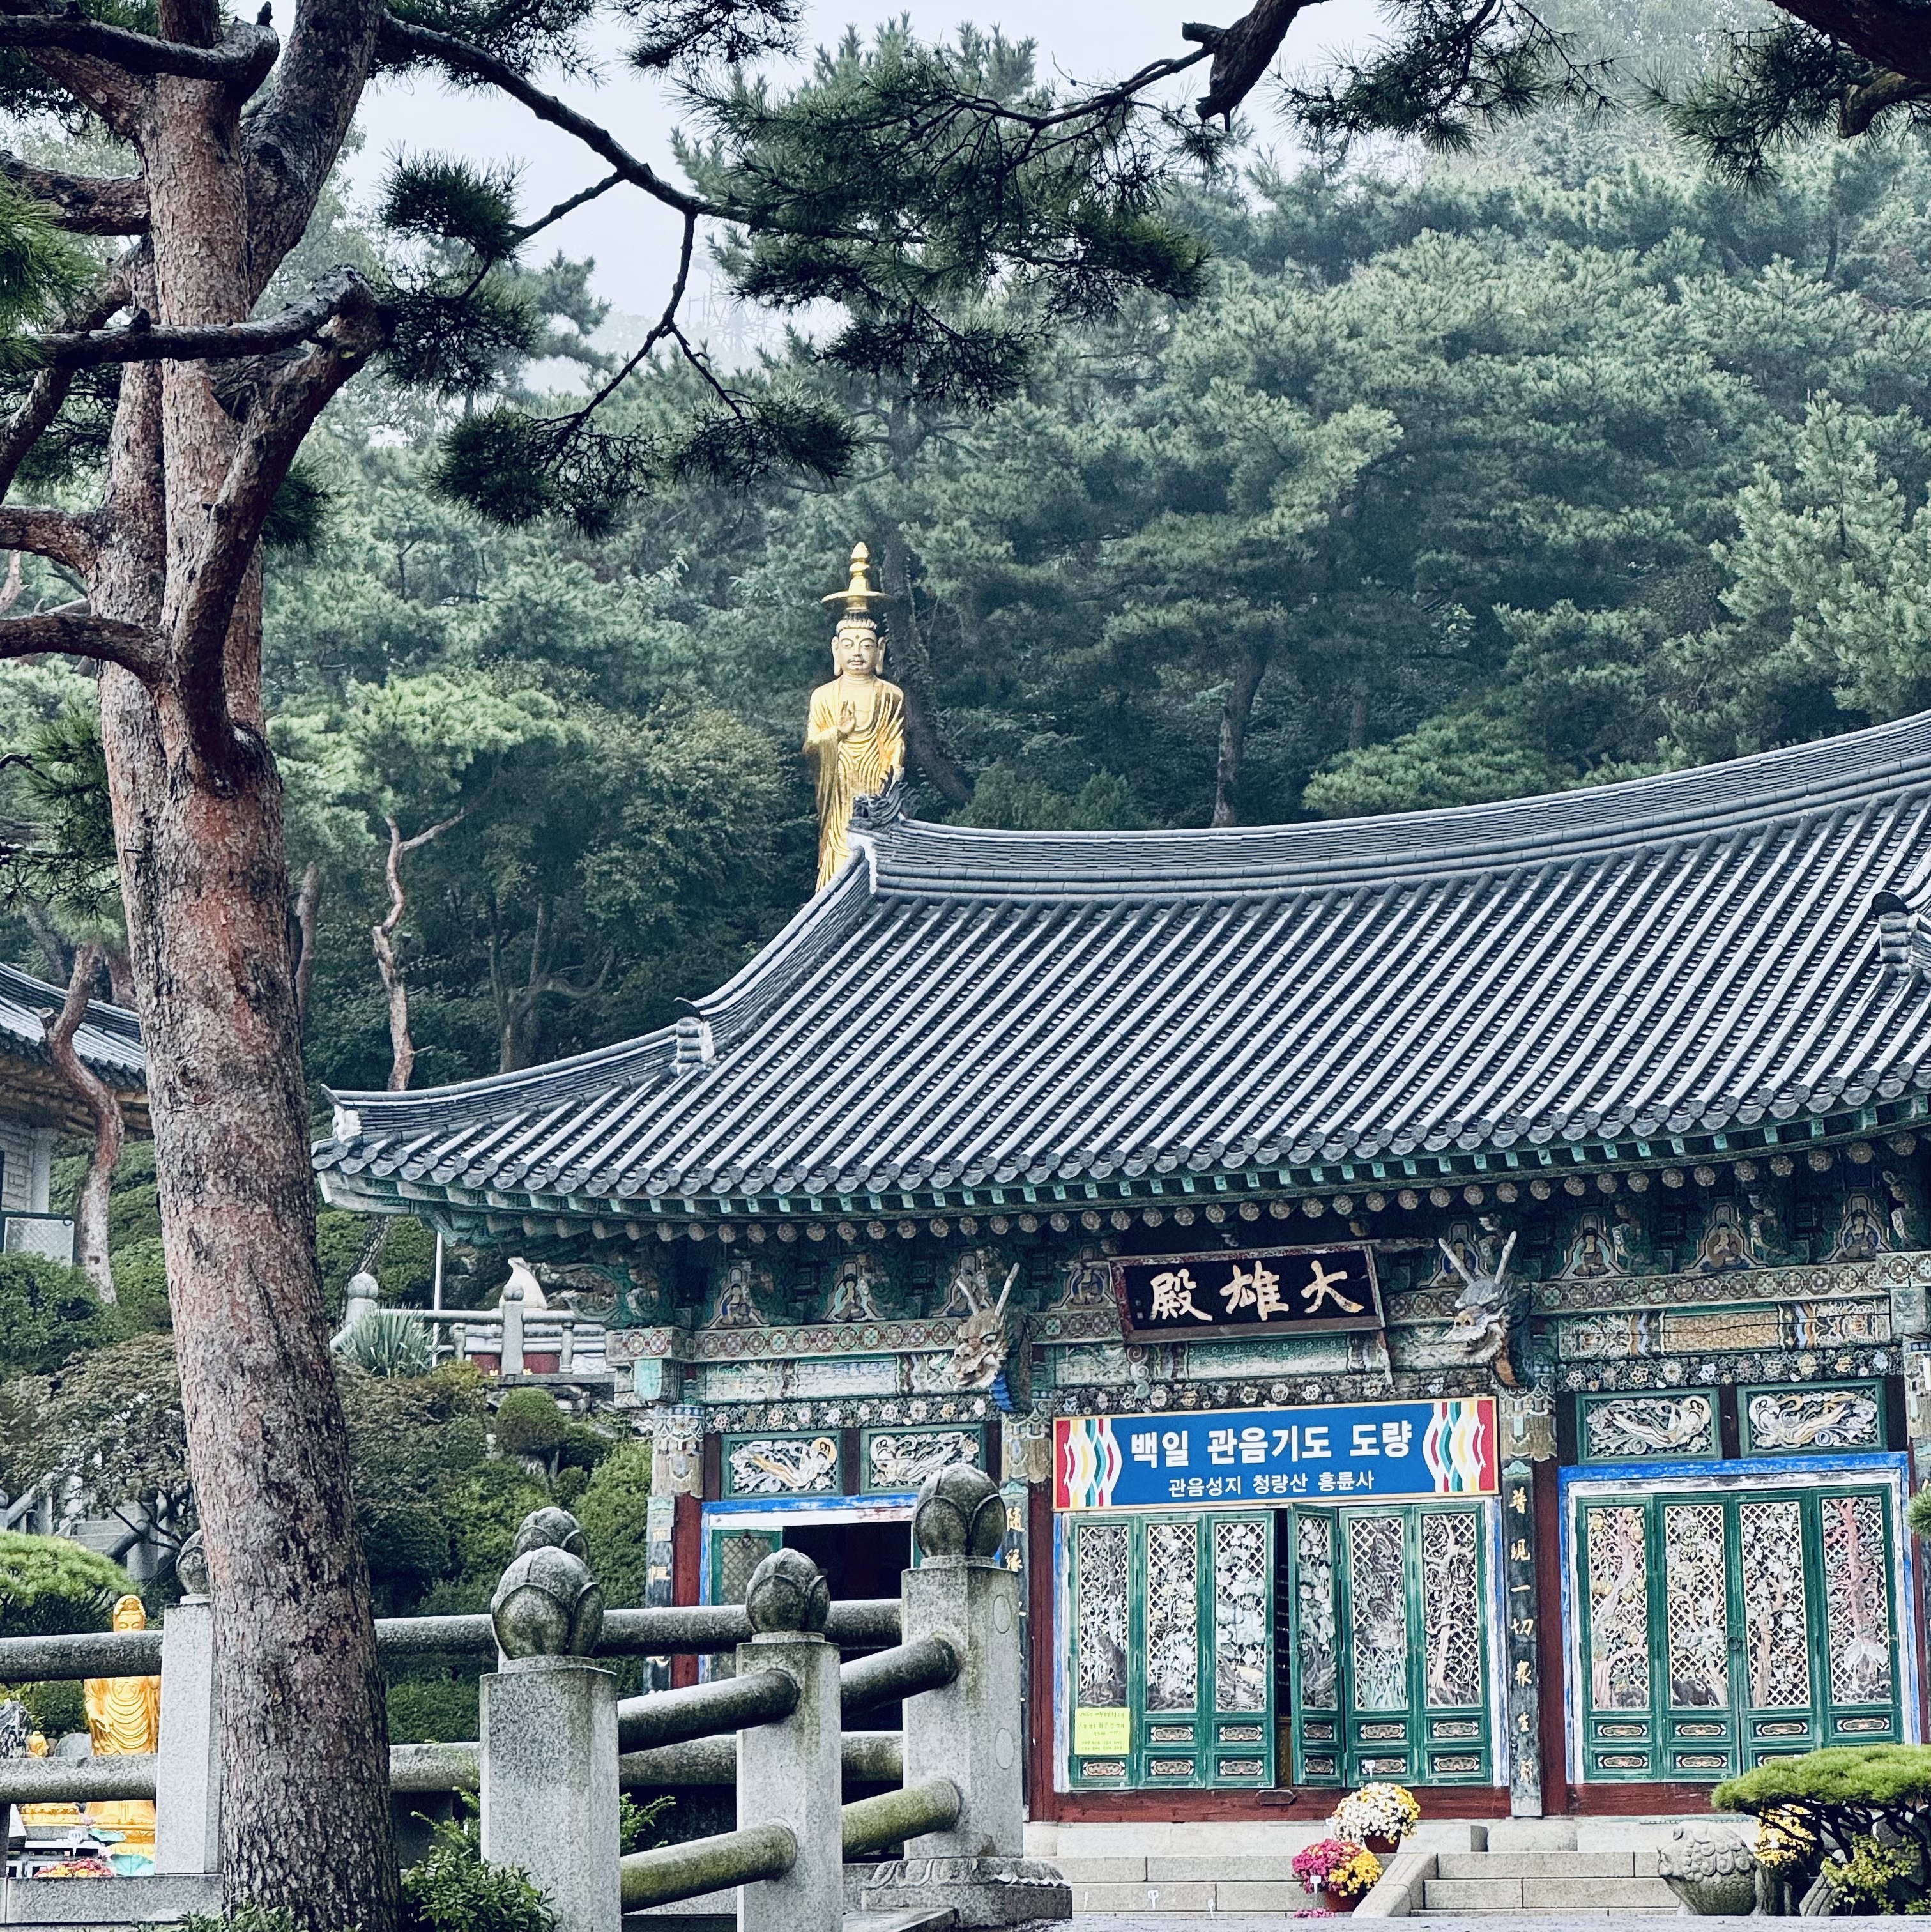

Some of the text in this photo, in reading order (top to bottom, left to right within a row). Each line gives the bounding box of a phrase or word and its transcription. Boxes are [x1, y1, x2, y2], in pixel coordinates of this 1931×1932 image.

[1131, 1420, 1412, 1469] 백일 관음기도 도량
[1168, 1470, 1375, 1498] 관음성지 청량산 흥륜사
